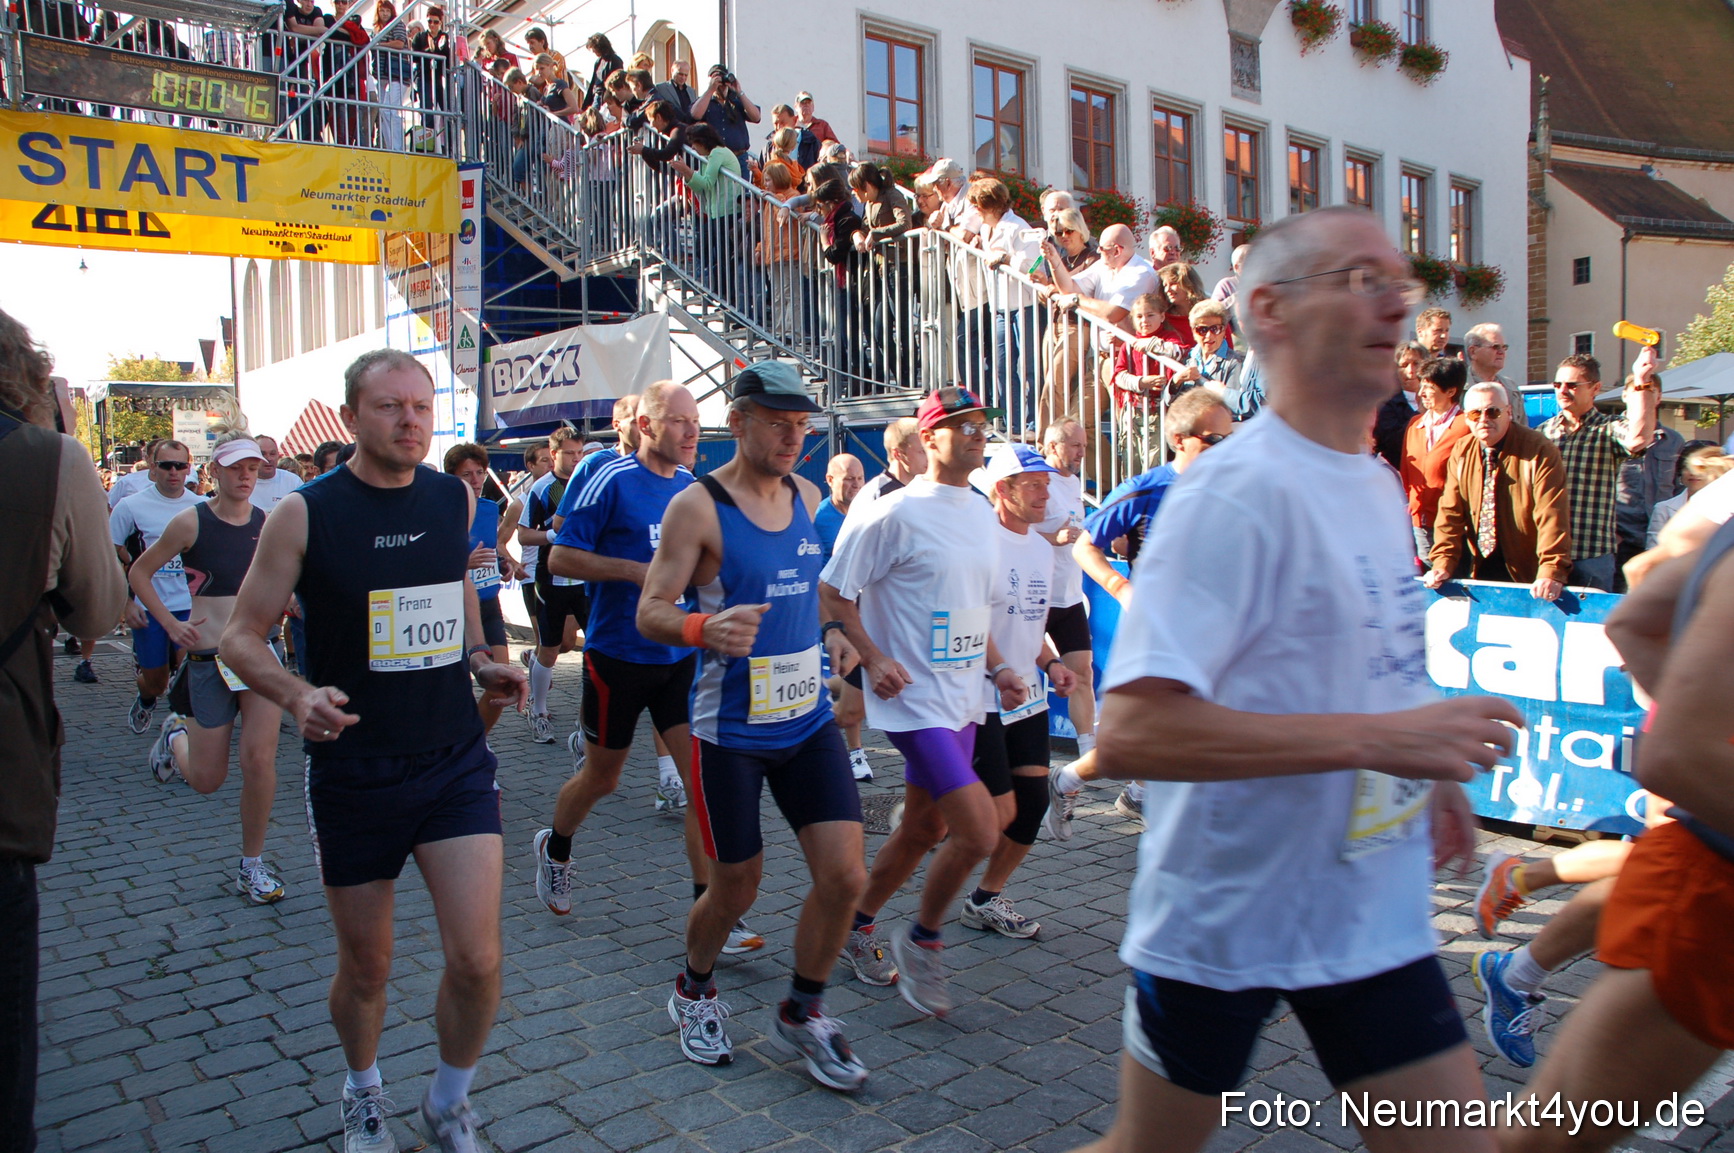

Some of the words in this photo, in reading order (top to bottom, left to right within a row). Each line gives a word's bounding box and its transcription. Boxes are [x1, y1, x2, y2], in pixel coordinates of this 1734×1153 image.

[29, 37, 90, 57] SPORTRONIC
[111, 53, 167, 69] Elektronische
[152, 70, 270, 119] 10:00:46
[17, 131, 260, 203] START
[300, 188, 371, 203] Neumarkter
[374, 194, 426, 208] Stadtlauf
[492, 344, 581, 397] BOCK
[374, 534, 408, 548] RUN
[168, 560, 183, 569] 32
[476, 565, 496, 580] 2211
[766, 580, 810, 598] München
[398, 595, 432, 612] Franz
[402, 618, 457, 647] 1007
[952, 632, 985, 653] 3744
[1425, 597, 1655, 711] Car
[773, 661, 800, 675] Heinz
[776, 676, 817, 703] 1006
